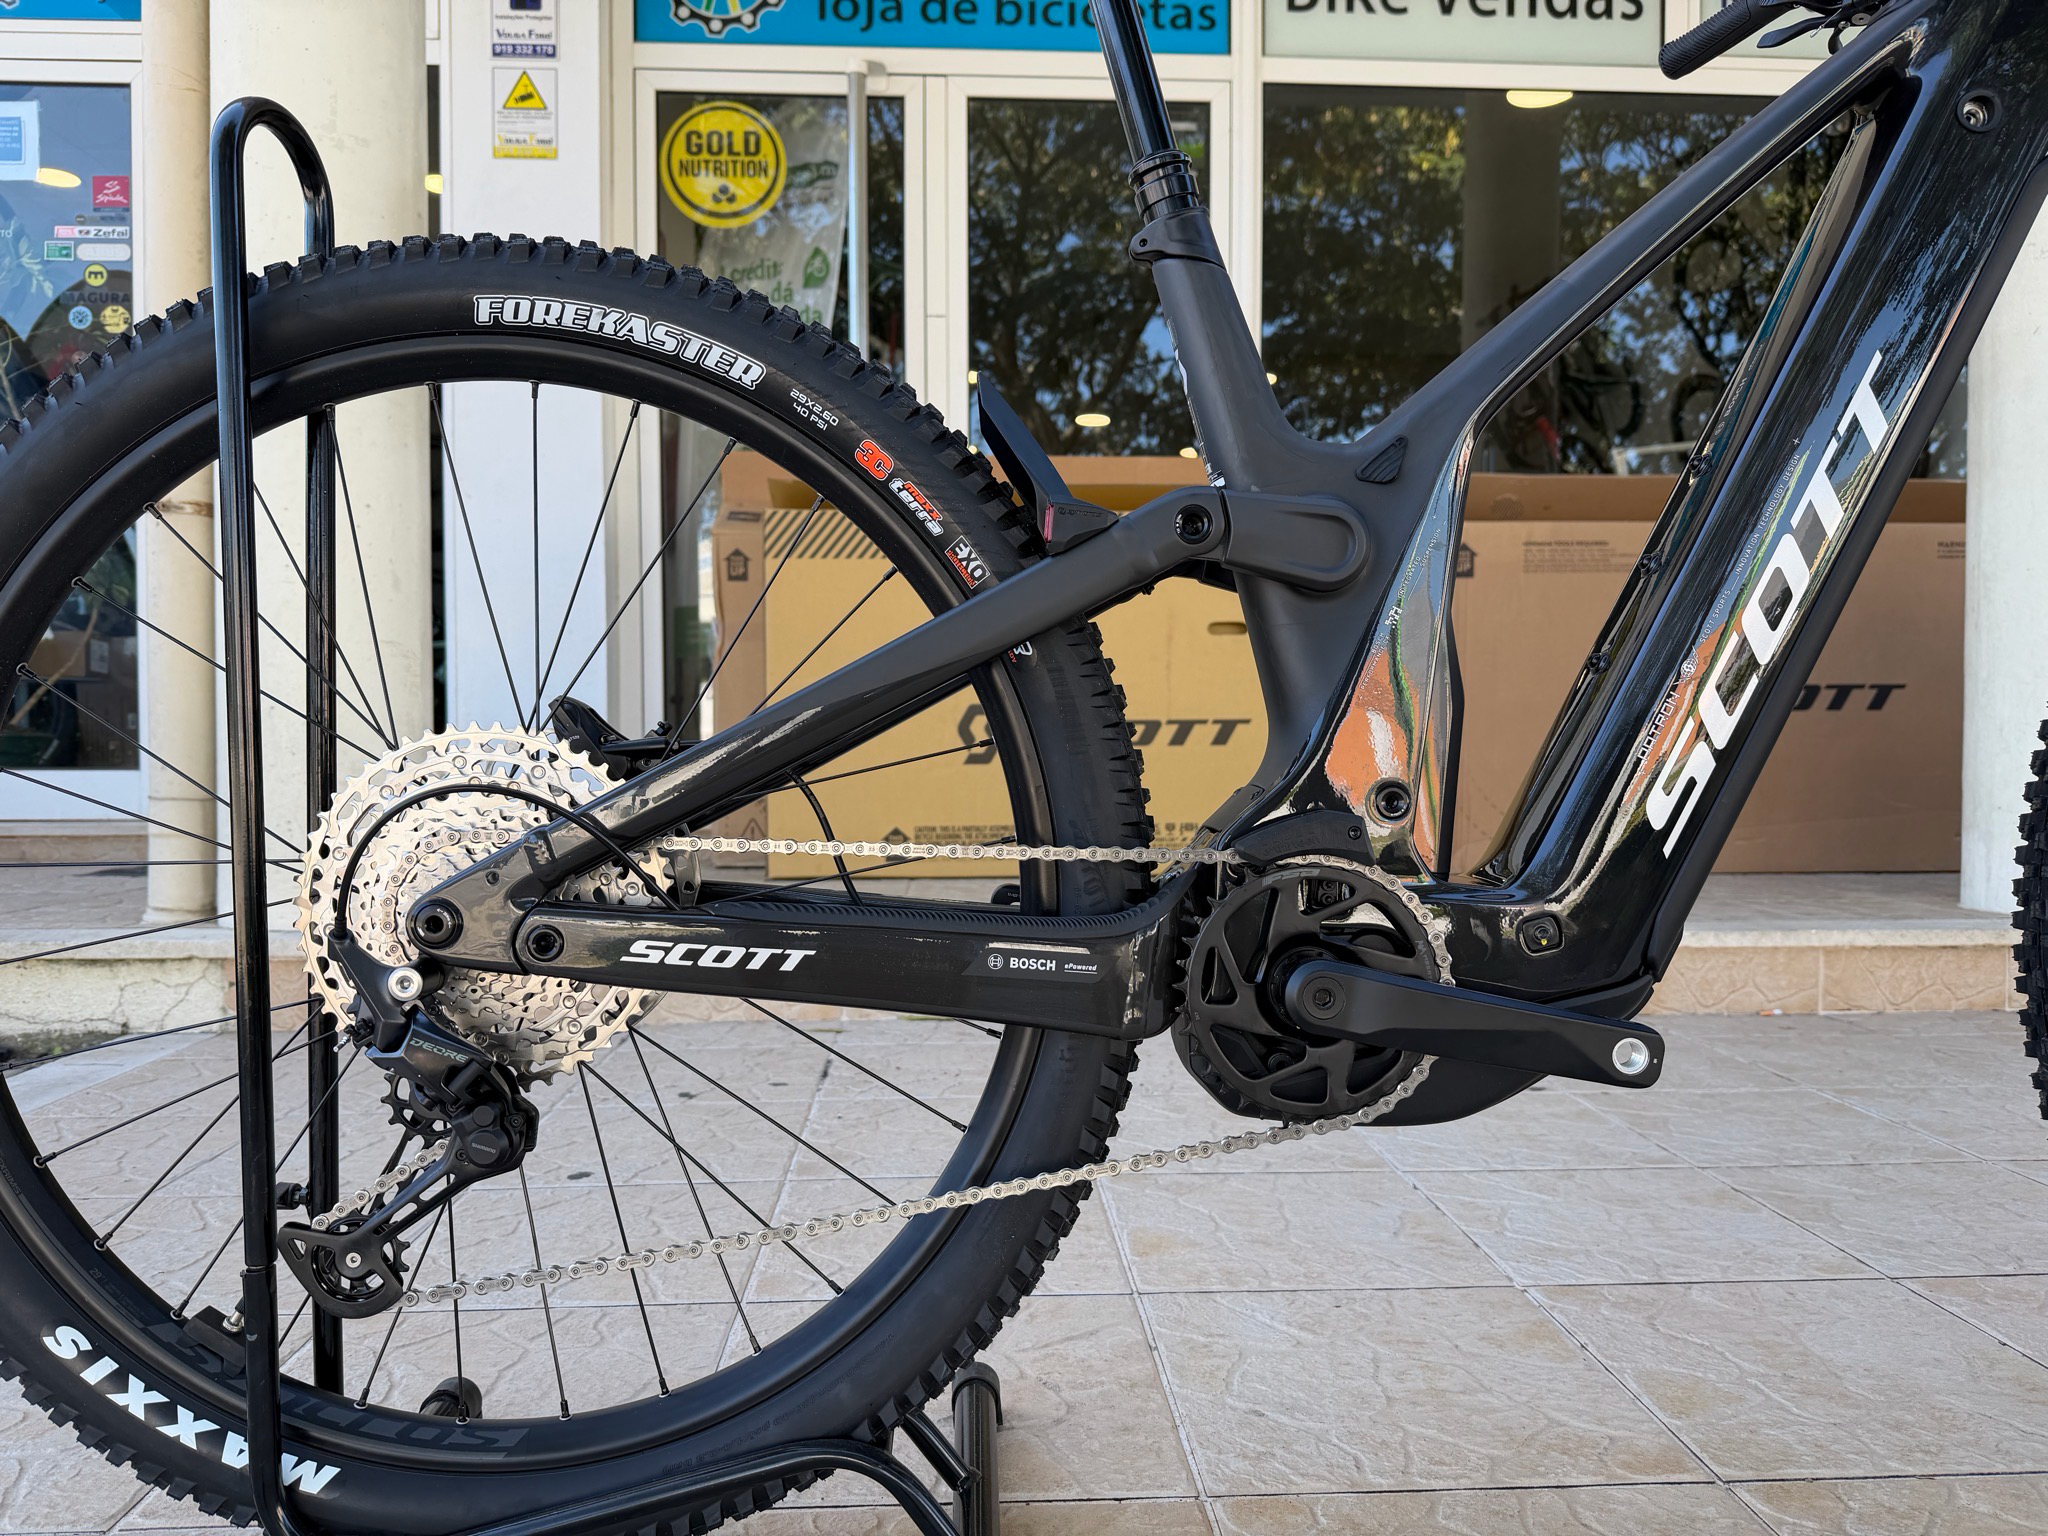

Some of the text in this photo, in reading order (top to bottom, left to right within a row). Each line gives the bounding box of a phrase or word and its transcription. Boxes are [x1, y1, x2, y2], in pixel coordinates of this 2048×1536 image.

[920, 0, 978, 25] de
[685, 129, 762, 156] GOLD
[678, 158, 769, 177] NUTRITION
[473, 294, 767, 391] FOREKASTER
[789, 388, 839, 427] 29X2.60
[809, 412, 829, 431] PSI
[855, 439, 894, 481] 3C
[1419, 527, 1442, 567] SUSPENSION
[1712, 588, 1732, 619] SPORTS
[1734, 532, 1761, 575] INNOVATION
[1757, 484, 1786, 531] TECHNOLOGY
[1782, 453, 1801, 481] DESIGN
[952, 539, 991, 580] EXO
[1645, 349, 1890, 860] SCOTT
[1793, 683, 1907, 711] OTT
[1126, 718, 1252, 747] OTT
[620, 940, 817, 972] SCOTT
[1009, 957, 1098, 972] BOSCH ePowered
[409, 1037, 469, 1063] DEORE
[471, 1142, 497, 1154] SHIMANO
[42, 1324, 341, 1494] MAXXIS
